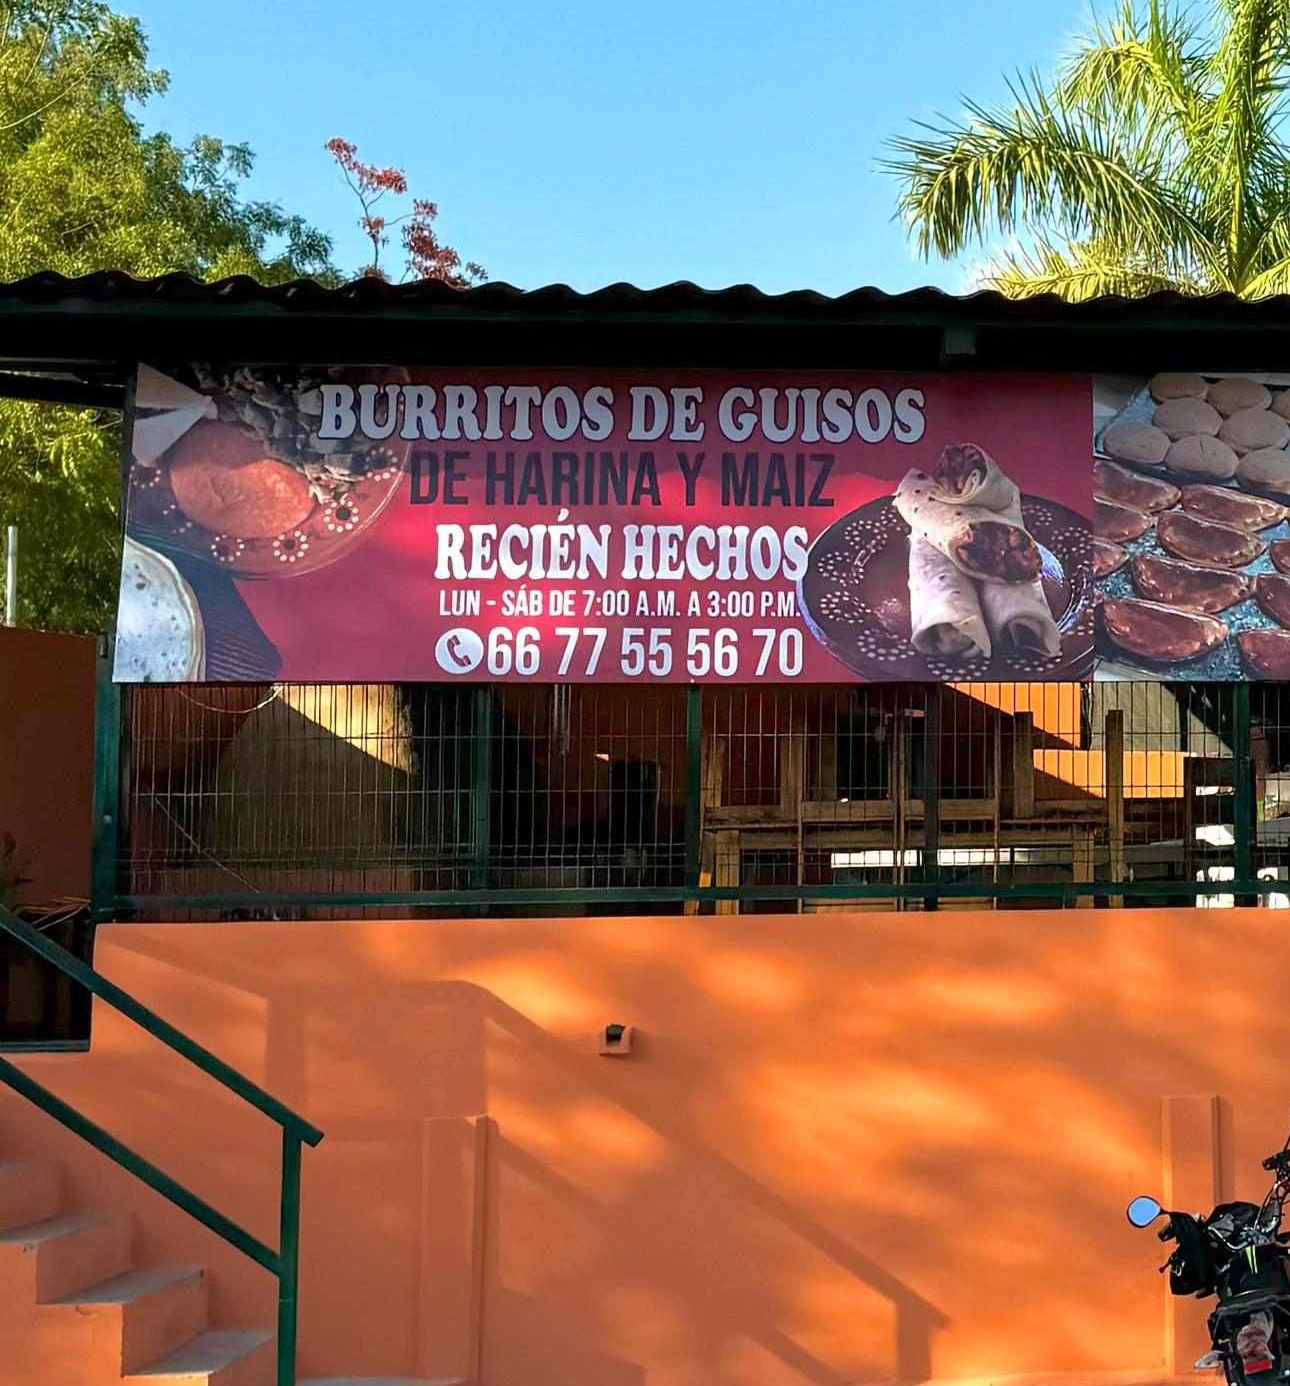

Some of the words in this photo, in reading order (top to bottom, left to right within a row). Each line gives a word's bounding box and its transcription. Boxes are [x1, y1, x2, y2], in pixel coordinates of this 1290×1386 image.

[318, 383, 614, 441] BURRITOS
[627, 385, 704, 442] DE
[717, 387, 926, 444] GUISOS
[410, 451, 469, 506] DE
[485, 451, 661, 506] HARINA
[676, 452, 706, 506] Y
[721, 452, 835, 507] MAIZ
[434, 508, 612, 580] RECIÉN
[621, 525, 809, 582] HECHOS
[440, 589, 480, 616] LUN
[501, 584, 543, 616] SÁB
[549, 590, 576, 616] DE
[582, 590, 629, 617] 7:00
[635, 590, 681, 617] A.M.
[687, 591, 701, 617] A
[707, 591, 754, 617] 3:00
[760, 591, 801, 617] P.M.
[487, 626, 541, 675] 66
[554, 627, 607, 676] 77
[620, 628, 672, 676] 55
[686, 628, 738, 676] 56
[752, 628, 802, 677] 70
